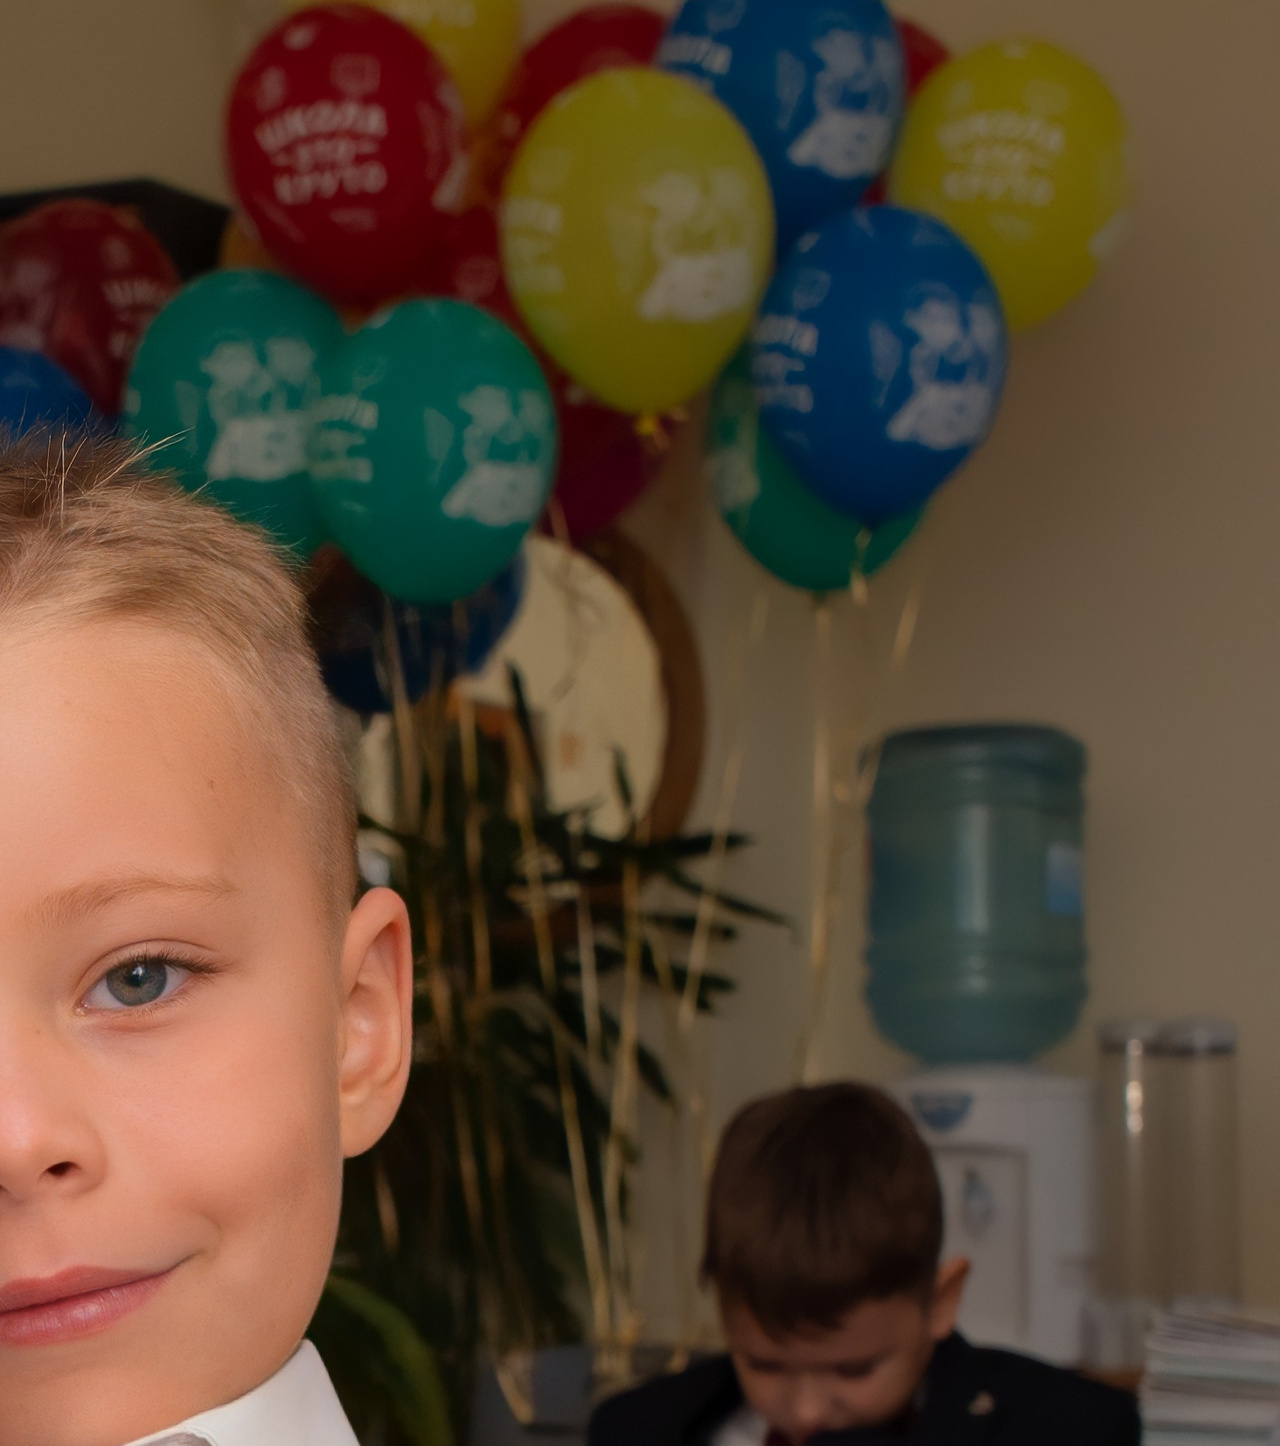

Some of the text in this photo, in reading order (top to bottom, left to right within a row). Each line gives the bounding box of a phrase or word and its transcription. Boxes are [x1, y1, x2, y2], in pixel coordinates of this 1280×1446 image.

[253, 98, 388, 152] ШКОЛА
[936, 106, 1066, 153] ШКОЛА
[273, 161, 387, 204] КРУТО
[941, 164, 1055, 207] КРУТО
